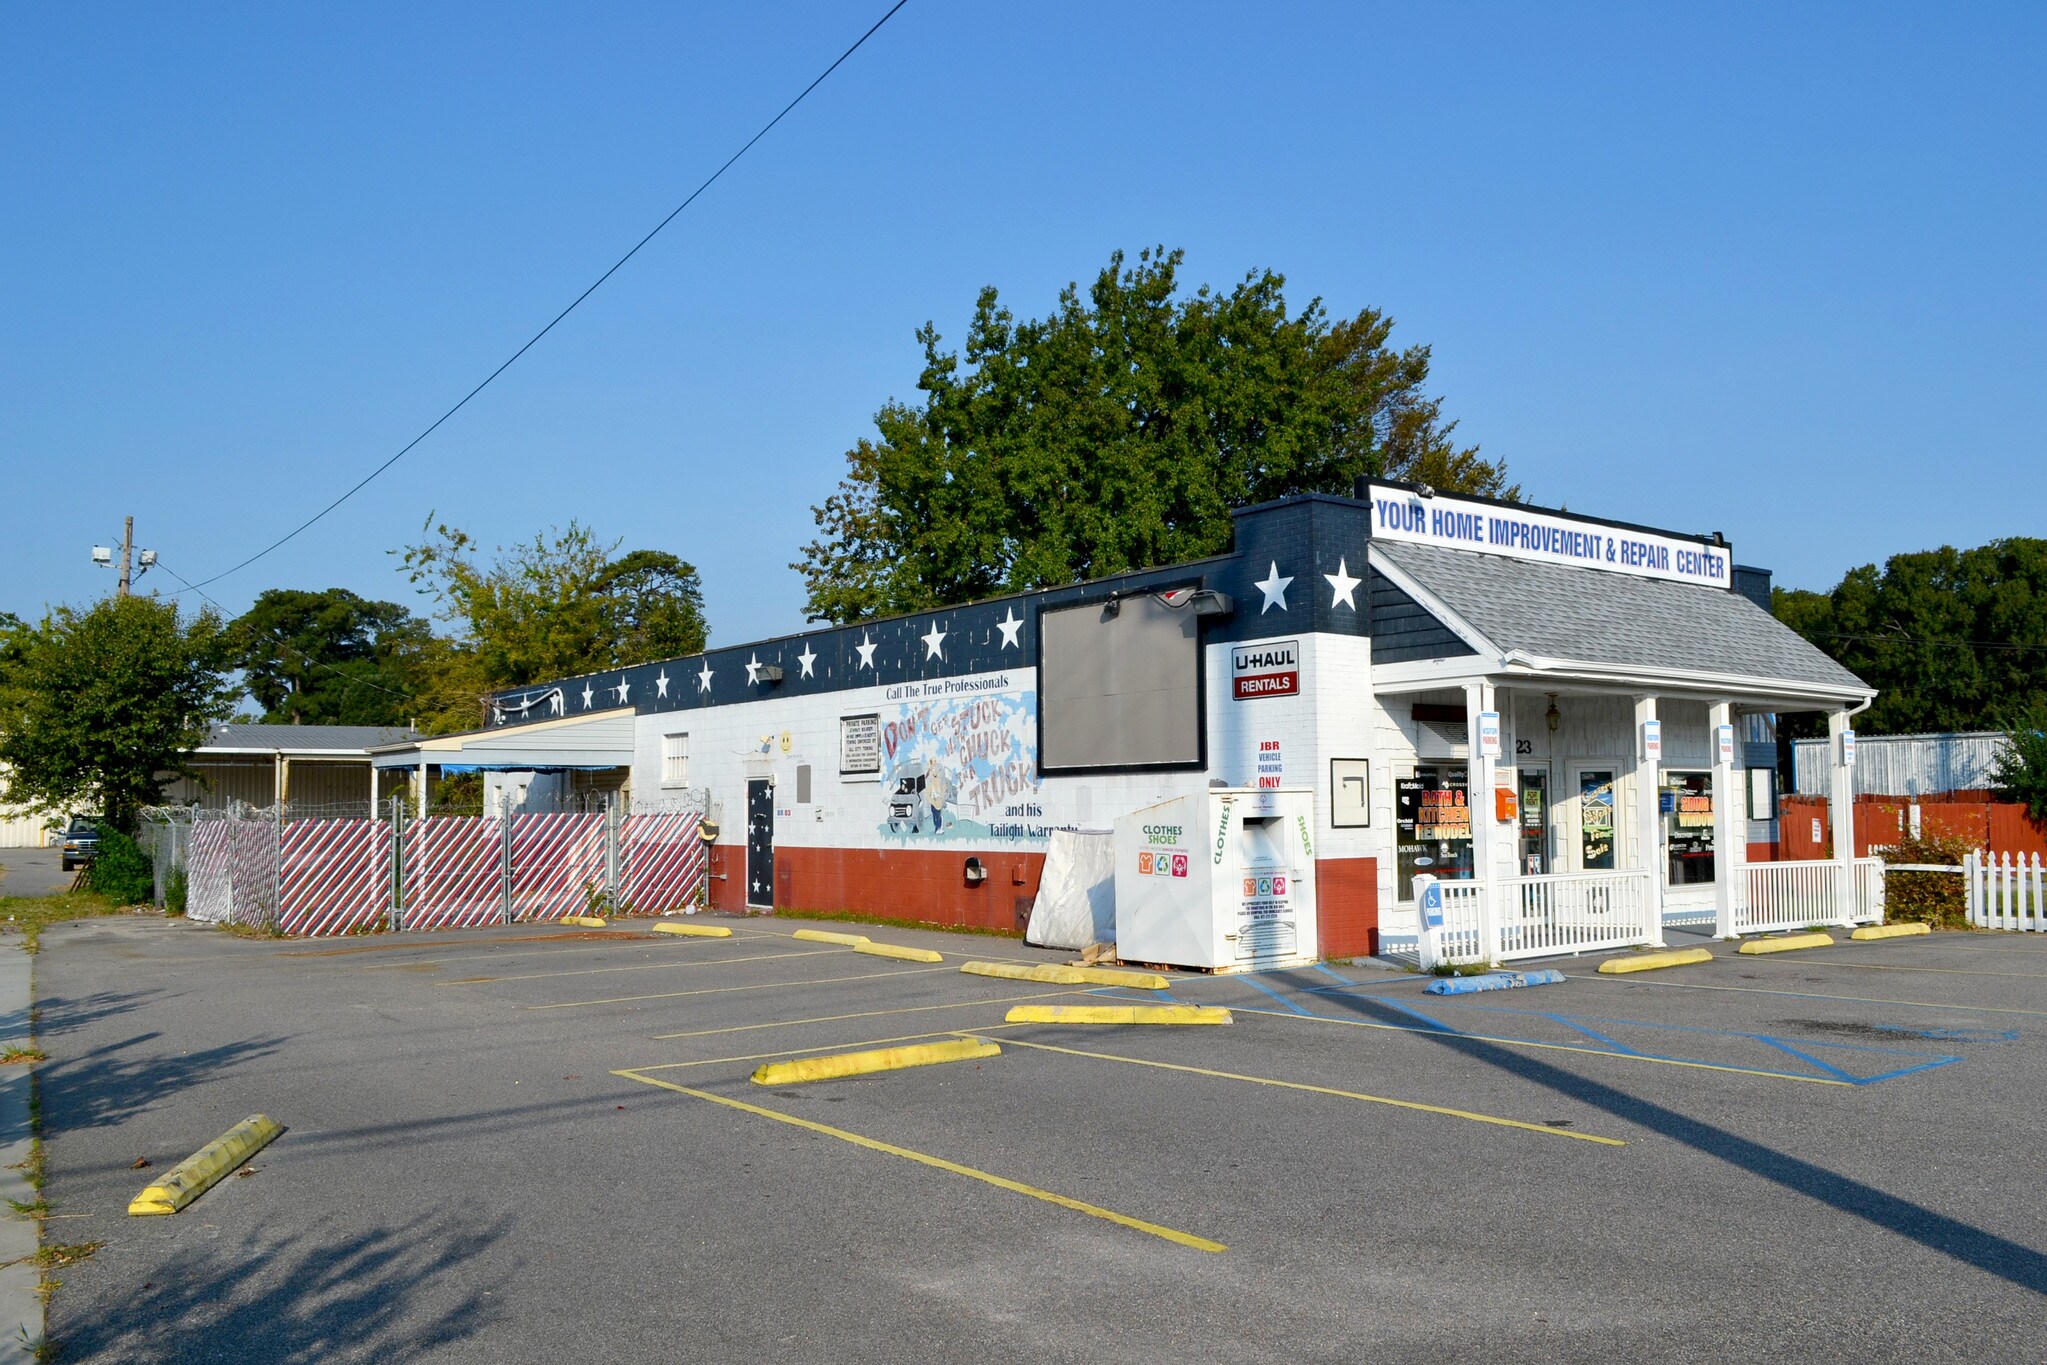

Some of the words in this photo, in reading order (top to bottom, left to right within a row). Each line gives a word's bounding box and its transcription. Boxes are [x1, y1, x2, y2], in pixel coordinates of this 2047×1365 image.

[1376, 499, 1426, 534] YOUR
[1432, 508, 1484, 542] HOME
[1489, 517, 1602, 560] IMPROVEMENT
[1606, 537, 1616, 563] &
[1621, 540, 1669, 570] REPAIR
[1676, 550, 1724, 579] CENTER
[1236, 650, 1295, 670] U-HAUL
[886, 687, 902, 701] Call
[904, 685, 920, 698] The
[923, 683, 943, 696] True
[945, 675, 1009, 694] Professionals
[1241, 676, 1290, 693] RENTALS
[951, 699, 1002, 736] STUCK
[960, 730, 1011, 766] CHUCK
[1260, 741, 1280, 751] JBR
[1259, 753, 1281, 762] VEHICLE
[1258, 764, 1283, 774] PARKING
[1259, 776, 1281, 788] ONLY
[1422, 790, 1453, 806] BATH
[1455, 790, 1465, 806] &
[1681, 796, 1709, 811] SIDING
[1005, 803, 1024, 817] and
[1026, 803, 1042, 817] his
[1418, 807, 1469, 823] KITCHEN
[1142, 825, 1182, 835] CLOTHES
[1214, 805, 1230, 865] CLOTHES
[1297, 815, 1312, 856] SHOES
[1148, 835, 1177, 845] SHOES
[1398, 845, 1428, 853] MOHAWK
[1585, 844, 1609, 860] Sale
